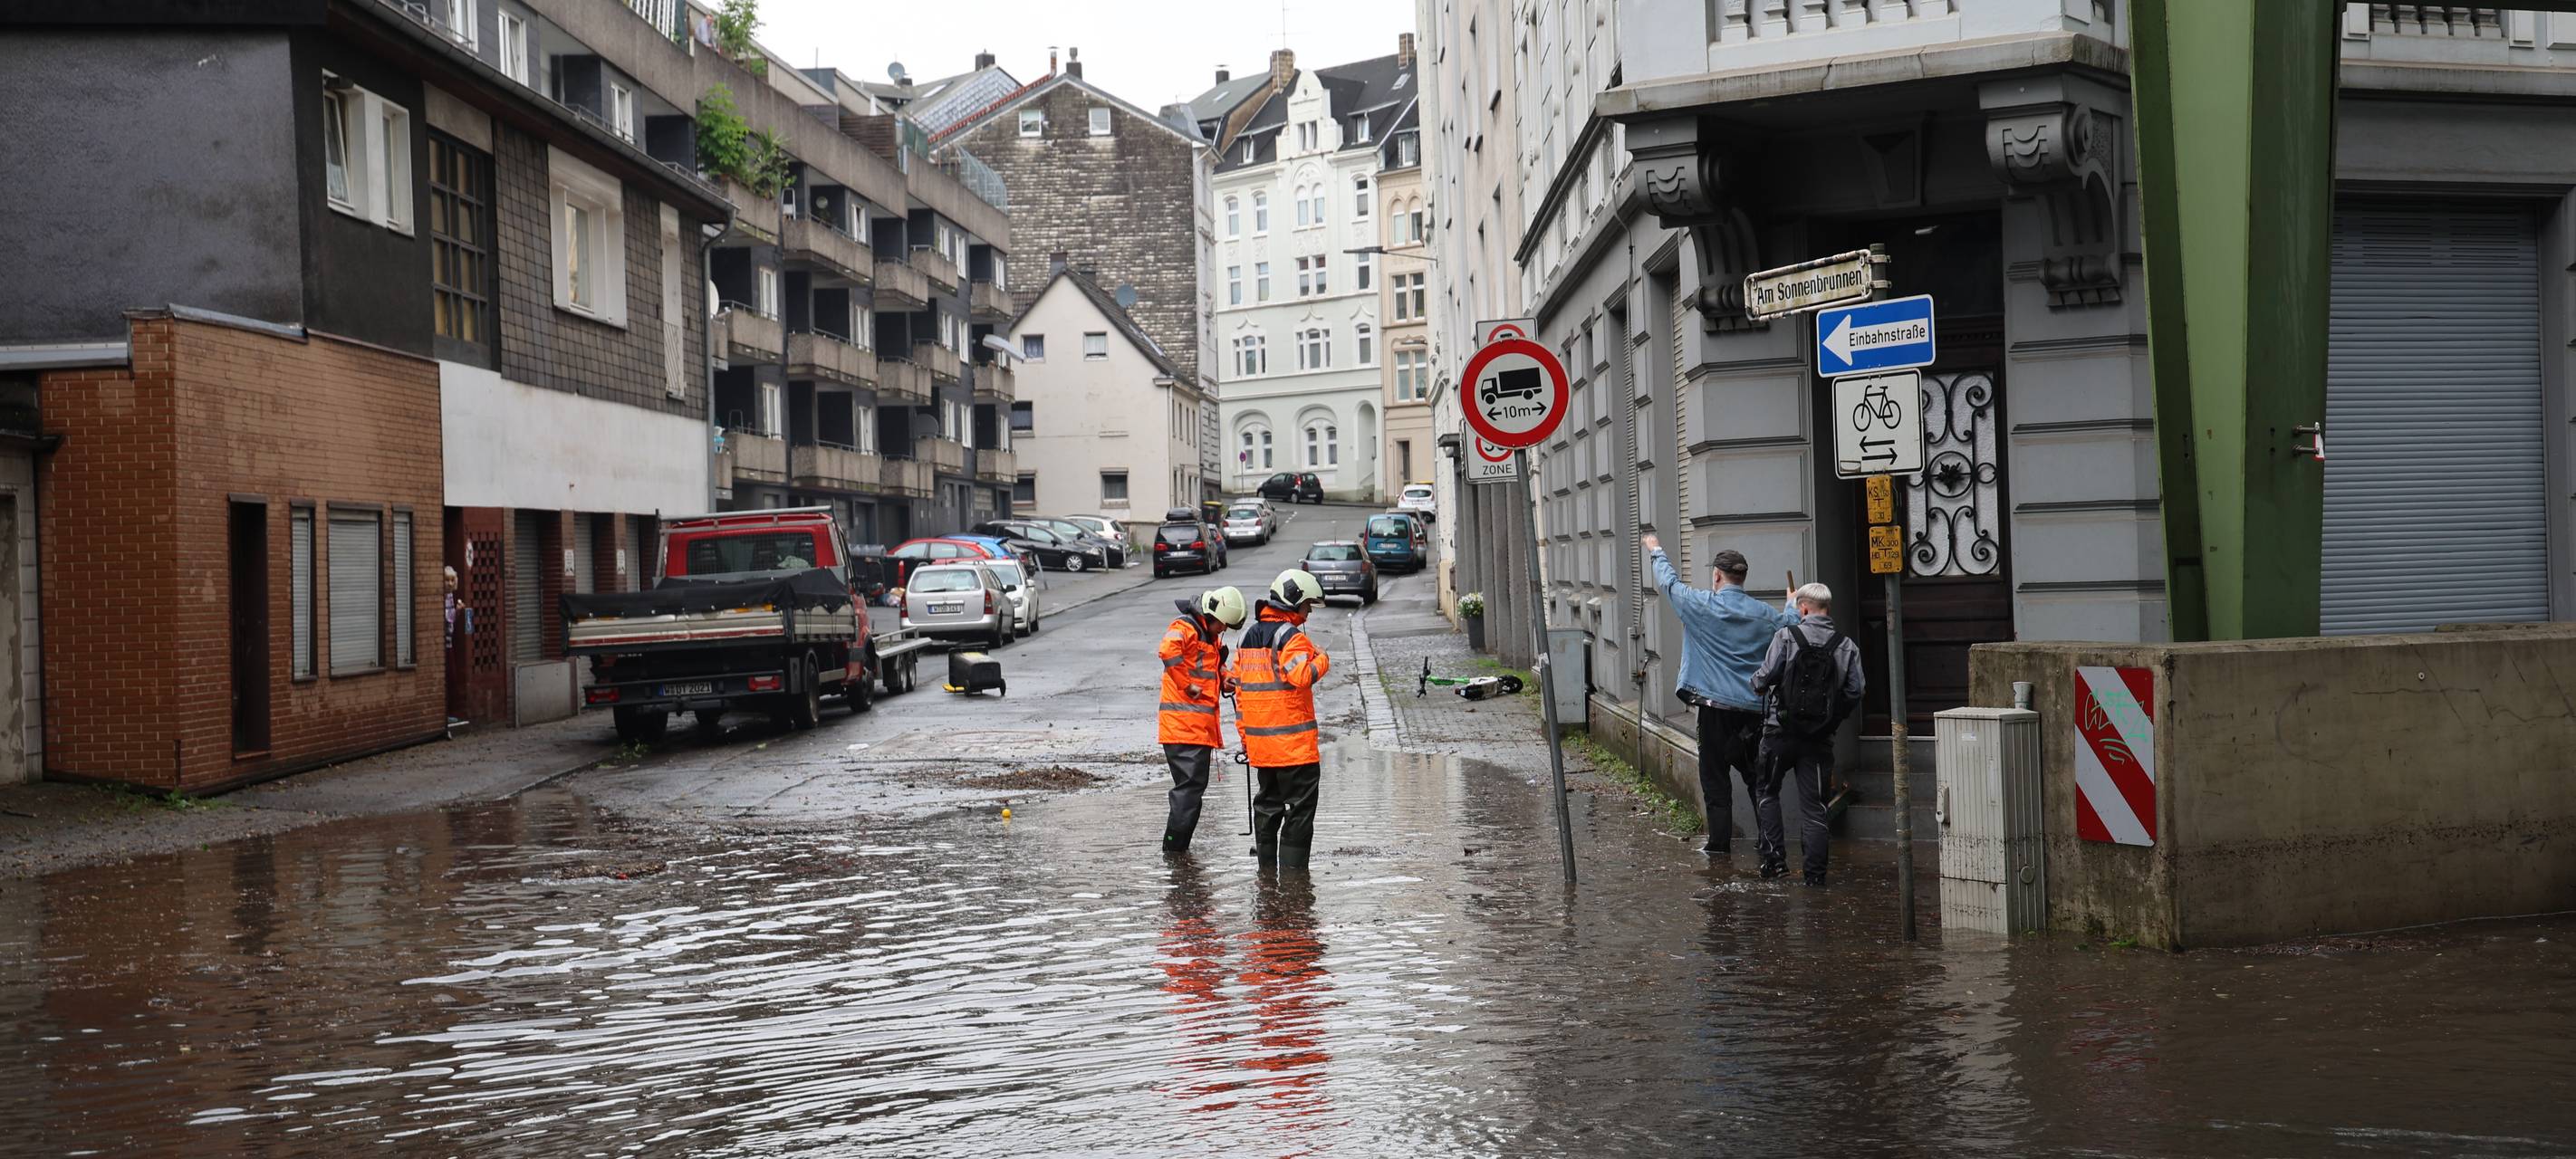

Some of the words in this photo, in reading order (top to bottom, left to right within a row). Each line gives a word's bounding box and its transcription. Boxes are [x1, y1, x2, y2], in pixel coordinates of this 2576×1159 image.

[1757, 286, 1774, 305] Am
[1777, 269, 1862, 302] Sonnenbrunnen
[1849, 324, 1926, 347] Einbahnstraße
[1504, 406, 1531, 418] 10m
[1483, 464, 1513, 475] ZONE
[1871, 536, 1885, 548] MK
[688, 682, 710, 693] 2021
